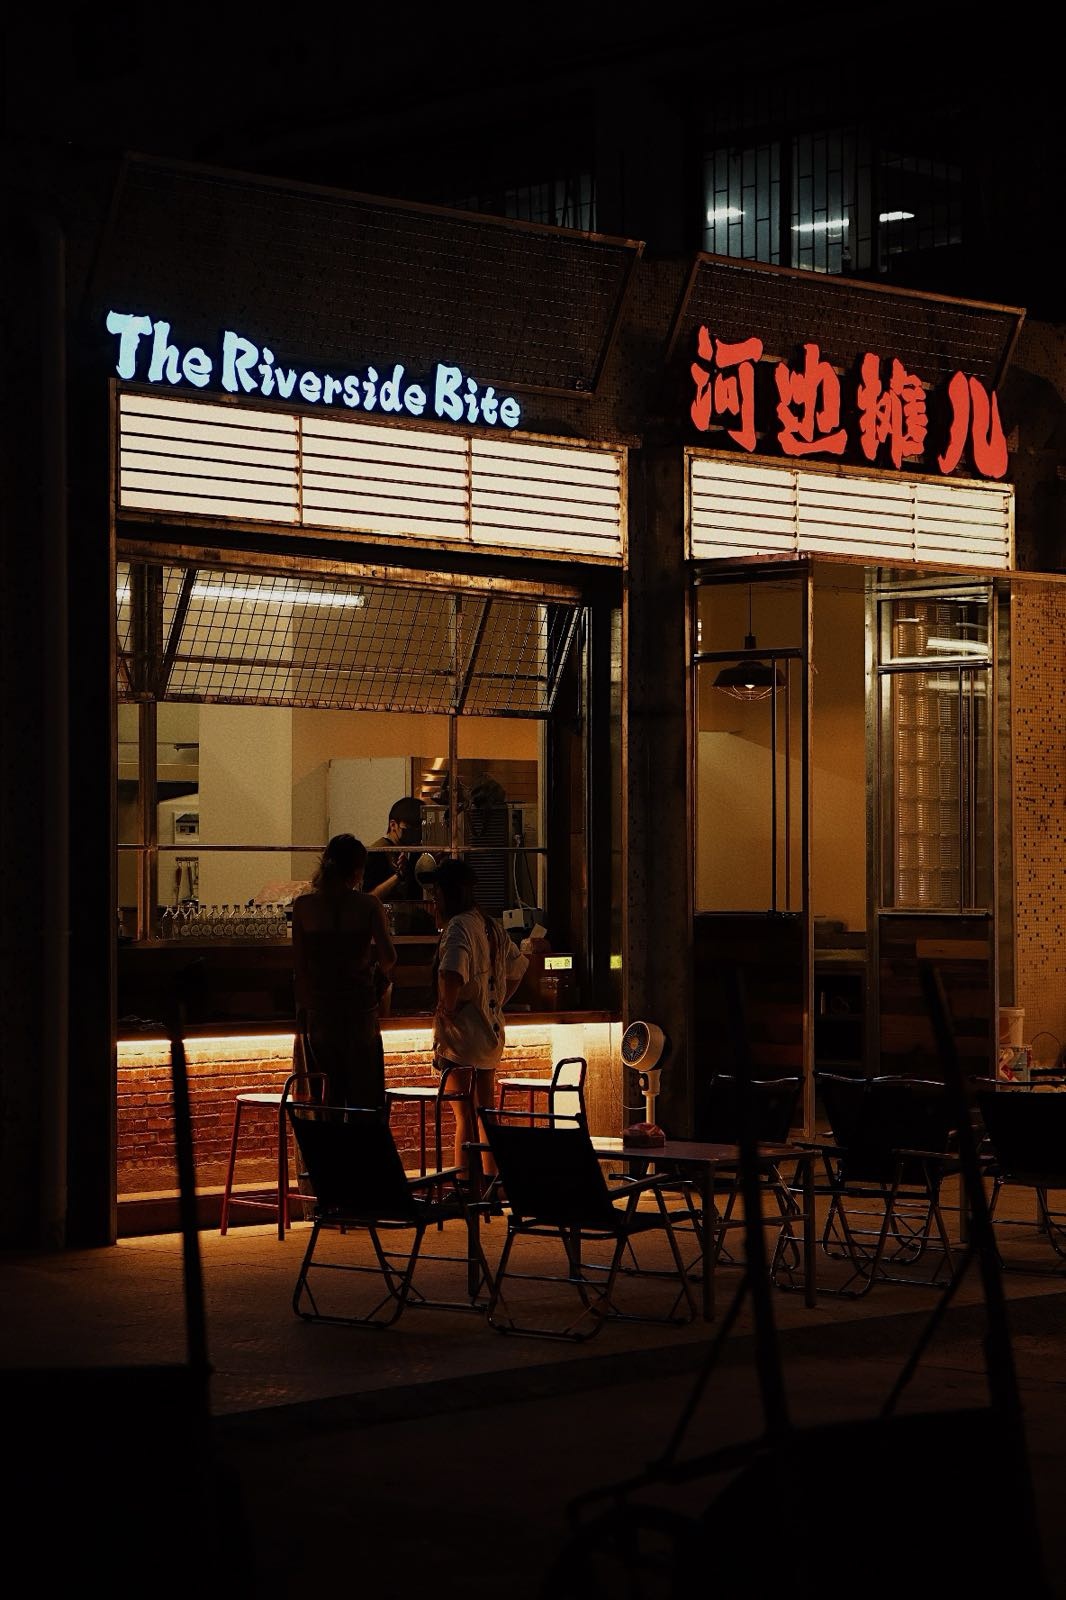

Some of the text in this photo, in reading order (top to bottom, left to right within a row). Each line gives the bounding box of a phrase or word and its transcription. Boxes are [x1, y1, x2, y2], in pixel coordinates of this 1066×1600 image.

[106, 310, 521, 428] The Riverside Bite
